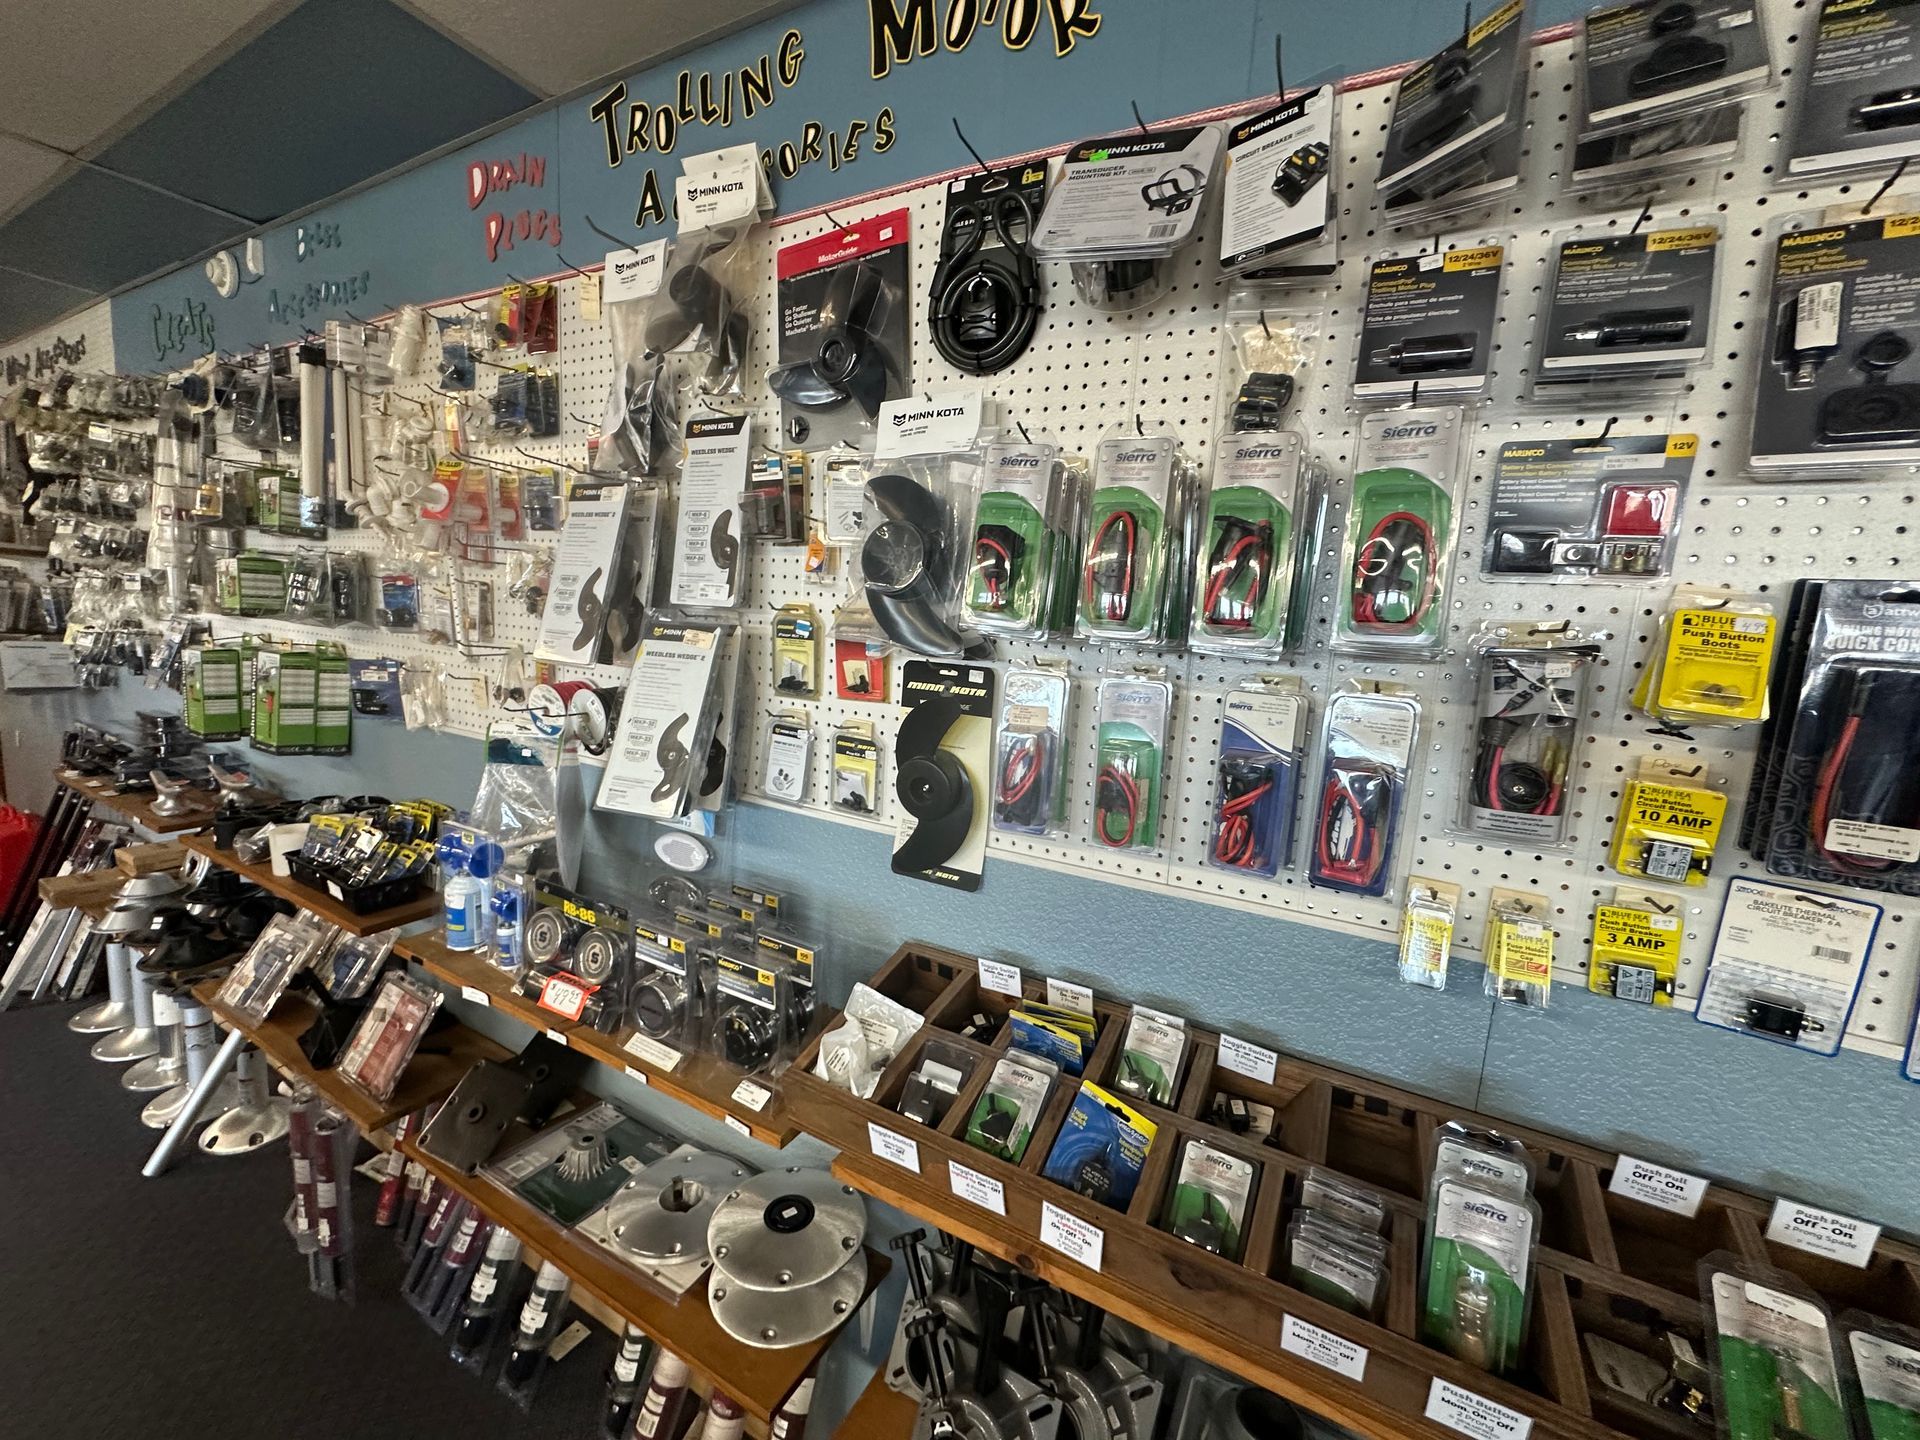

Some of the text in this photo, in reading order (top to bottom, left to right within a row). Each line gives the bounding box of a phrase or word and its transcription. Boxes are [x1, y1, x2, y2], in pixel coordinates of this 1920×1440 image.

[591, 29, 805, 168] TROLLING
[1250, 117, 1274, 134] MINN
[1275, 105, 1299, 125] KOTA
[1132, 142, 1166, 152] KOTA
[1235, 133, 1293, 163] CIRCUIT BREAKER
[1068, 171, 1112, 181] MOUNTING
[1113, 169, 1127, 177] KIT
[1070, 165, 1125, 175] TRANSDUCER
[467, 151, 547, 210] DRAIN
[699, 181, 744, 198] MINN KOTA
[485, 208, 562, 263] PLUGS
[1782, 230, 1846, 247] MARINCO
[625, 254, 656, 271] MINN KOTA
[818, 246, 859, 264] MotorGuide
[1374, 250, 1499, 275] MARINCO 12/24/36V
[1418, 281, 1436, 291] Plug
[792, 304, 808, 313] Faster
[792, 309, 818, 320] Shallower
[153, 298, 216, 362] CLEATS
[793, 317, 812, 327] Quieter
[908, 407, 965, 423] MINN KOTA
[690, 448, 717, 456] WEEDLESS
[1503, 440, 1695, 458] MARINCO 12V
[1702, 615, 1737, 625] BLUE
[1682, 628, 1765, 643] Push Button
[1701, 638, 1741, 649] Boots
[1823, 635, 1882, 650] QUICK
[645, 650, 676, 659] WEEDLESS
[949, 685, 988, 697] KOTA
[1638, 795, 1692, 808] Push Button
[1650, 787, 1692, 800] BLUE SEA
[1636, 800, 1705, 815] Circuit Breaker
[1638, 809, 1713, 829] 10 AMP
[935, 871, 960, 881] KOTA
[564, 900, 596, 924] RB-86
[1611, 910, 1650, 921] BLUE SEA
[1746, 904, 1781, 917] CIRCUIT
[1752, 899, 1838, 921] BAKELITE THERMAL
[1599, 923, 1663, 938] Circuit Breaker
[1600, 918, 1651, 931] Push Button
[1506, 942, 1548, 954] Fuse Holder
[1607, 932, 1666, 950] 3 AMP
[1506, 948, 1549, 959] Replacement
[1519, 954, 1534, 962] Cap
[1222, 1037, 1274, 1061] Toggle Switch
[1240, 1053, 1258, 1066] Prong
[951, 1163, 975, 1178] Toggle
[1634, 1163, 1688, 1186] Push Pull
[1632, 1170, 1685, 1193] Off On
[1631, 1178, 1658, 1194] Prong
[1659, 1186, 1688, 1202] Screw
[1045, 1204, 1100, 1239] Toggle Switch
[1057, 1219, 1078, 1233] Lighted
[1793, 1217, 1854, 1240] Off On
[1795, 1209, 1857, 1232] Push Pull
[1050, 1221, 1092, 1248] On Off On
[1064, 1235, 1084, 1250] Prong
[1792, 1226, 1822, 1243] Prong
[1823, 1233, 1857, 1250] Spade
[1292, 1320, 1358, 1354] Push Button
[1292, 1331, 1317, 1346] Mom.
[1318, 1343, 1332, 1352] On
[1339, 1351, 1355, 1362] Off
[1313, 1346, 1339, 1361] Prong
[1442, 1385, 1520, 1423] Push Button
[1441, 1396, 1516, 1433] Mom. On Off
[1464, 1414, 1495, 1433] Prong
